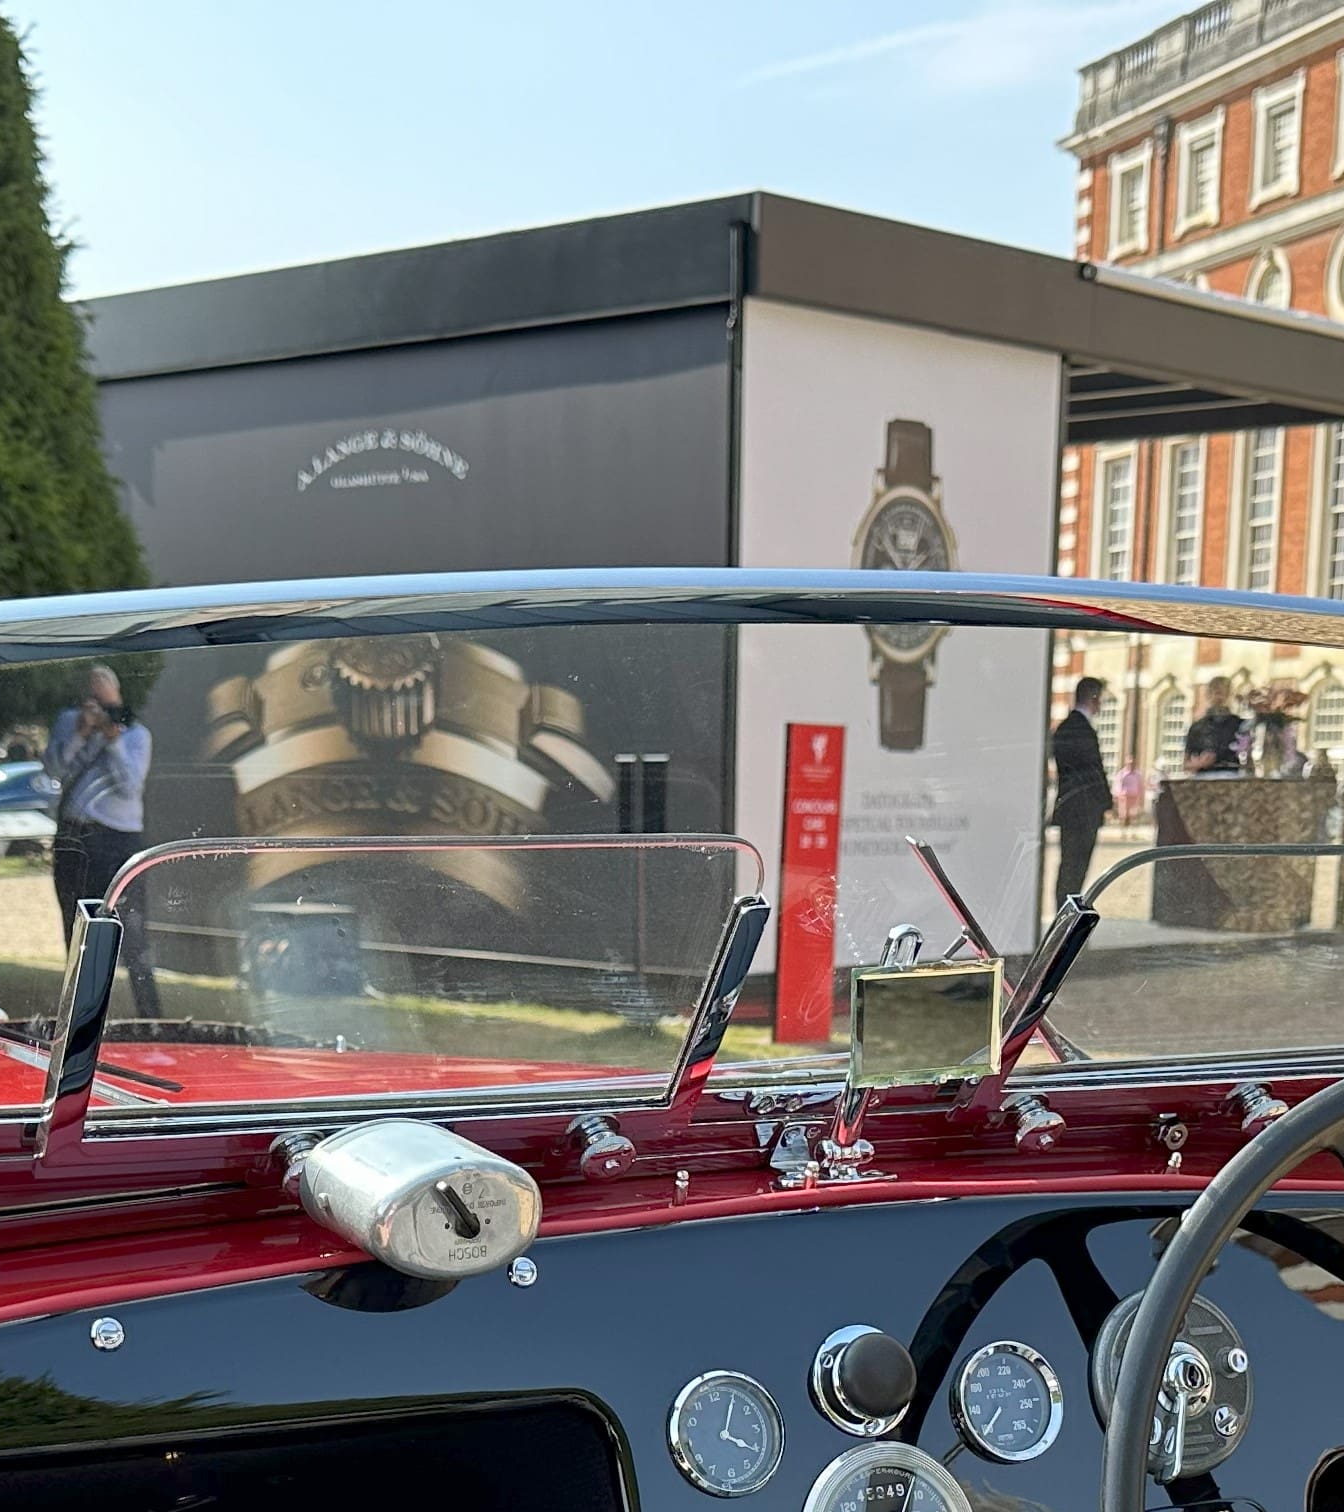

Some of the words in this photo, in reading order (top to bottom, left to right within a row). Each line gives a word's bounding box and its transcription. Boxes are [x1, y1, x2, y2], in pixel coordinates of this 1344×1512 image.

[448, 1245, 487, 1261] BOSCH
[977, 1367, 990, 1377] 200
[997, 1366, 1011, 1376] 220
[1012, 1379, 1026, 1389] 240
[708, 1392, 720, 1403] 12
[694, 1402, 703, 1411] 11
[1019, 1399, 1033, 1409] 250
[743, 1405, 751, 1415] 2
[751, 1424, 760, 1434] 3
[743, 1459, 751, 1470] 5
[708, 1465, 717, 1475] 7
[728, 1468, 736, 1478] 6
[913, 1489, 924, 1500] 10
[840, 1501, 857, 1512] 120
